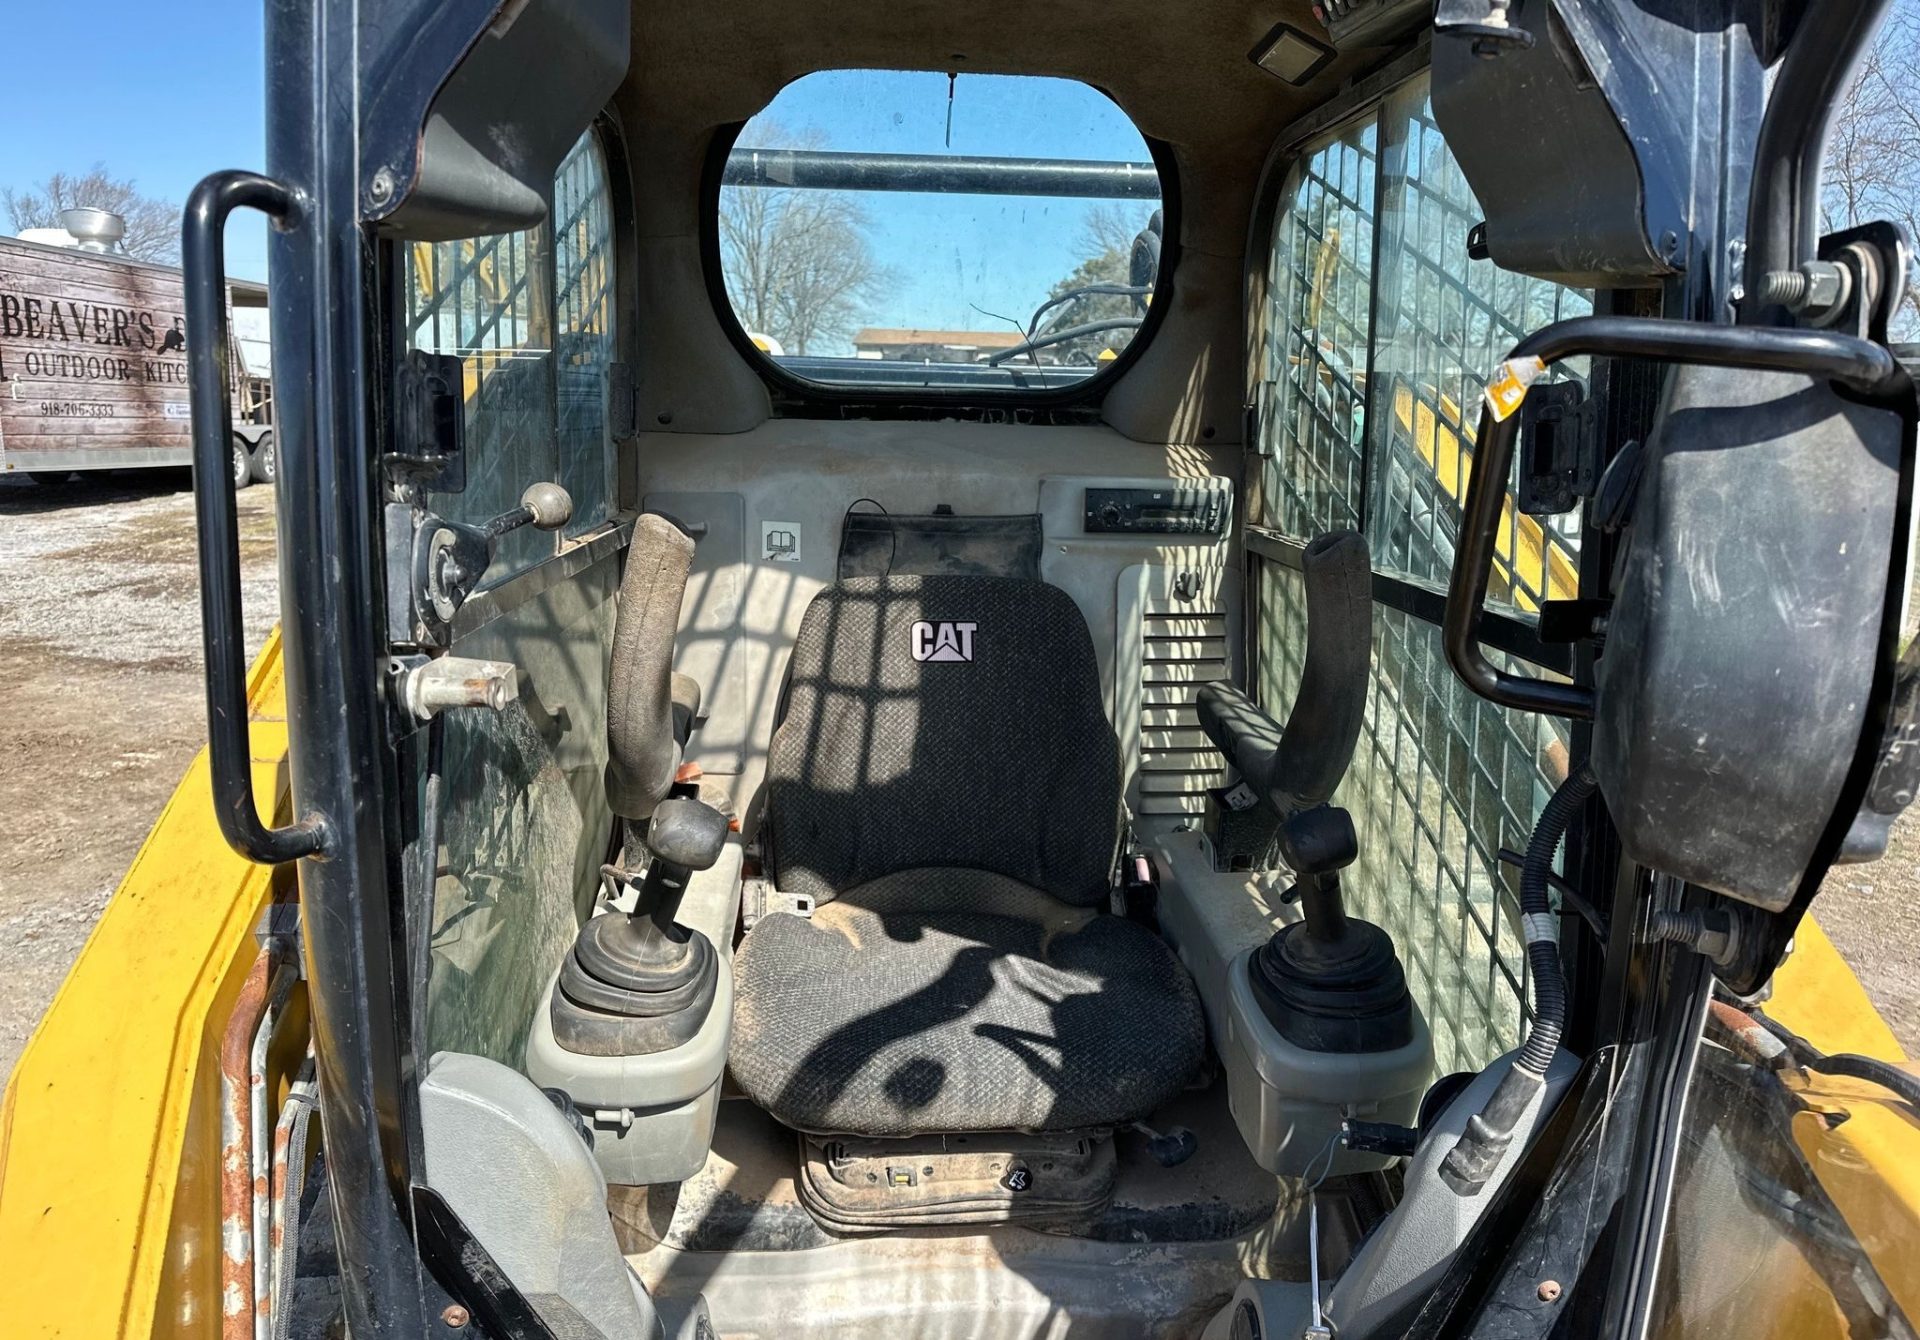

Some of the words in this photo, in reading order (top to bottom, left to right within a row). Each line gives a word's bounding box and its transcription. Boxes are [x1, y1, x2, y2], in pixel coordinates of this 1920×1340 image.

[1, 295, 155, 349] BEAVER'S
[25, 352, 130, 381] OUTDOOR
[146, 361, 188, 385] KITC
[911, 620, 978, 662] CAT
